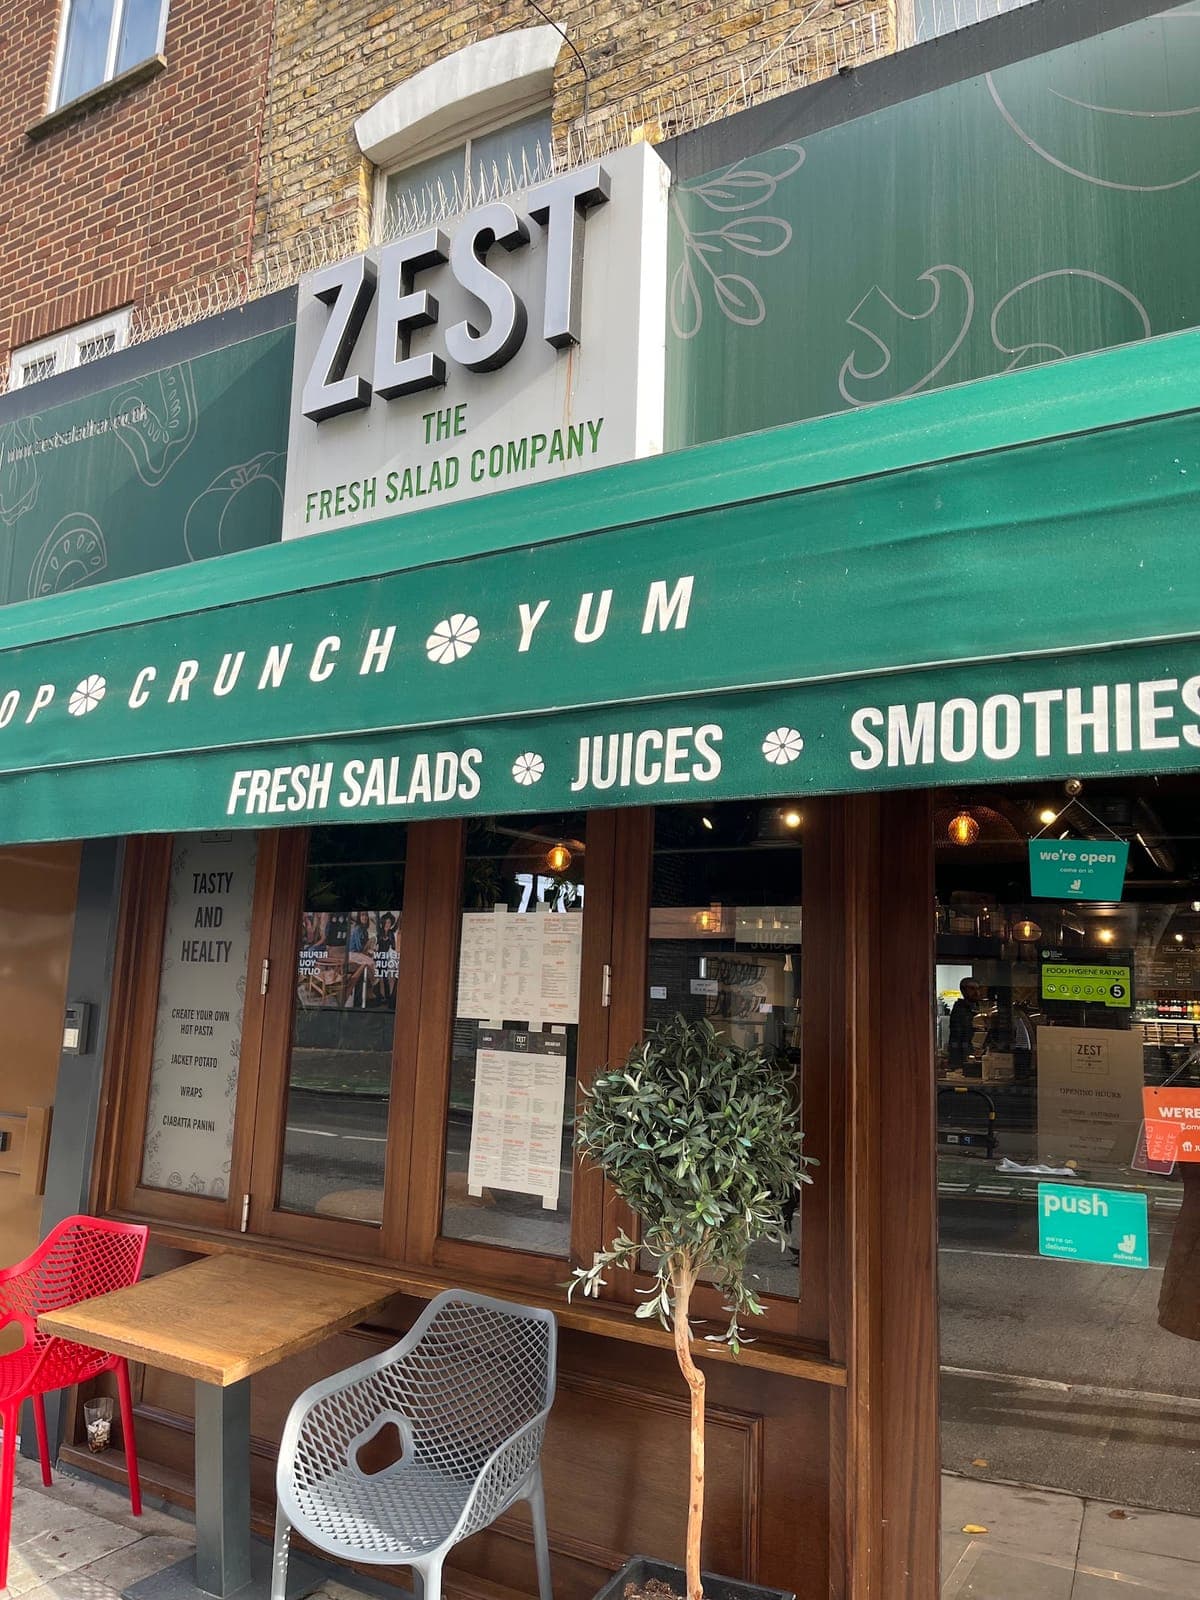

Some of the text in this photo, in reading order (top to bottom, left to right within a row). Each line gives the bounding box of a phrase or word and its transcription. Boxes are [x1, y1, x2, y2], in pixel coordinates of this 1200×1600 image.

[302, 163, 609, 423] ZEST
[7, 402, 149, 463] www.zestsaladbar.co.uk
[422, 403, 467, 444] THE
[305, 418, 604, 523] FRESH SALAD COMPANY
[128, 625, 396, 709] CRUNCH
[517, 575, 694, 653] YUM
[226, 762, 334, 815] FRESH
[339, 748, 483, 807] SALADS
[571, 724, 723, 792] JUICES
[1040, 849, 1116, 865] we're open
[193, 872, 233, 894] TASTY
[194, 906, 223, 928] AND
[181, 940, 232, 963] HEALTY
[1068, 968, 1098, 976] HYGIENE
[1113, 986, 1122, 997] 5
[171, 1008, 230, 1022] CREATE YOUR OWN
[180, 1024, 214, 1036] HOT PASTA
[1077, 1044, 1102, 1056] ZEST
[170, 1054, 218, 1068] JACKET POTATO
[180, 1086, 203, 1098] WRAPS
[1158, 1106, 1200, 1119] WE'RE
[162, 1115, 215, 1131] CIABATTA PANINI
[1044, 1193, 1109, 1217] push
